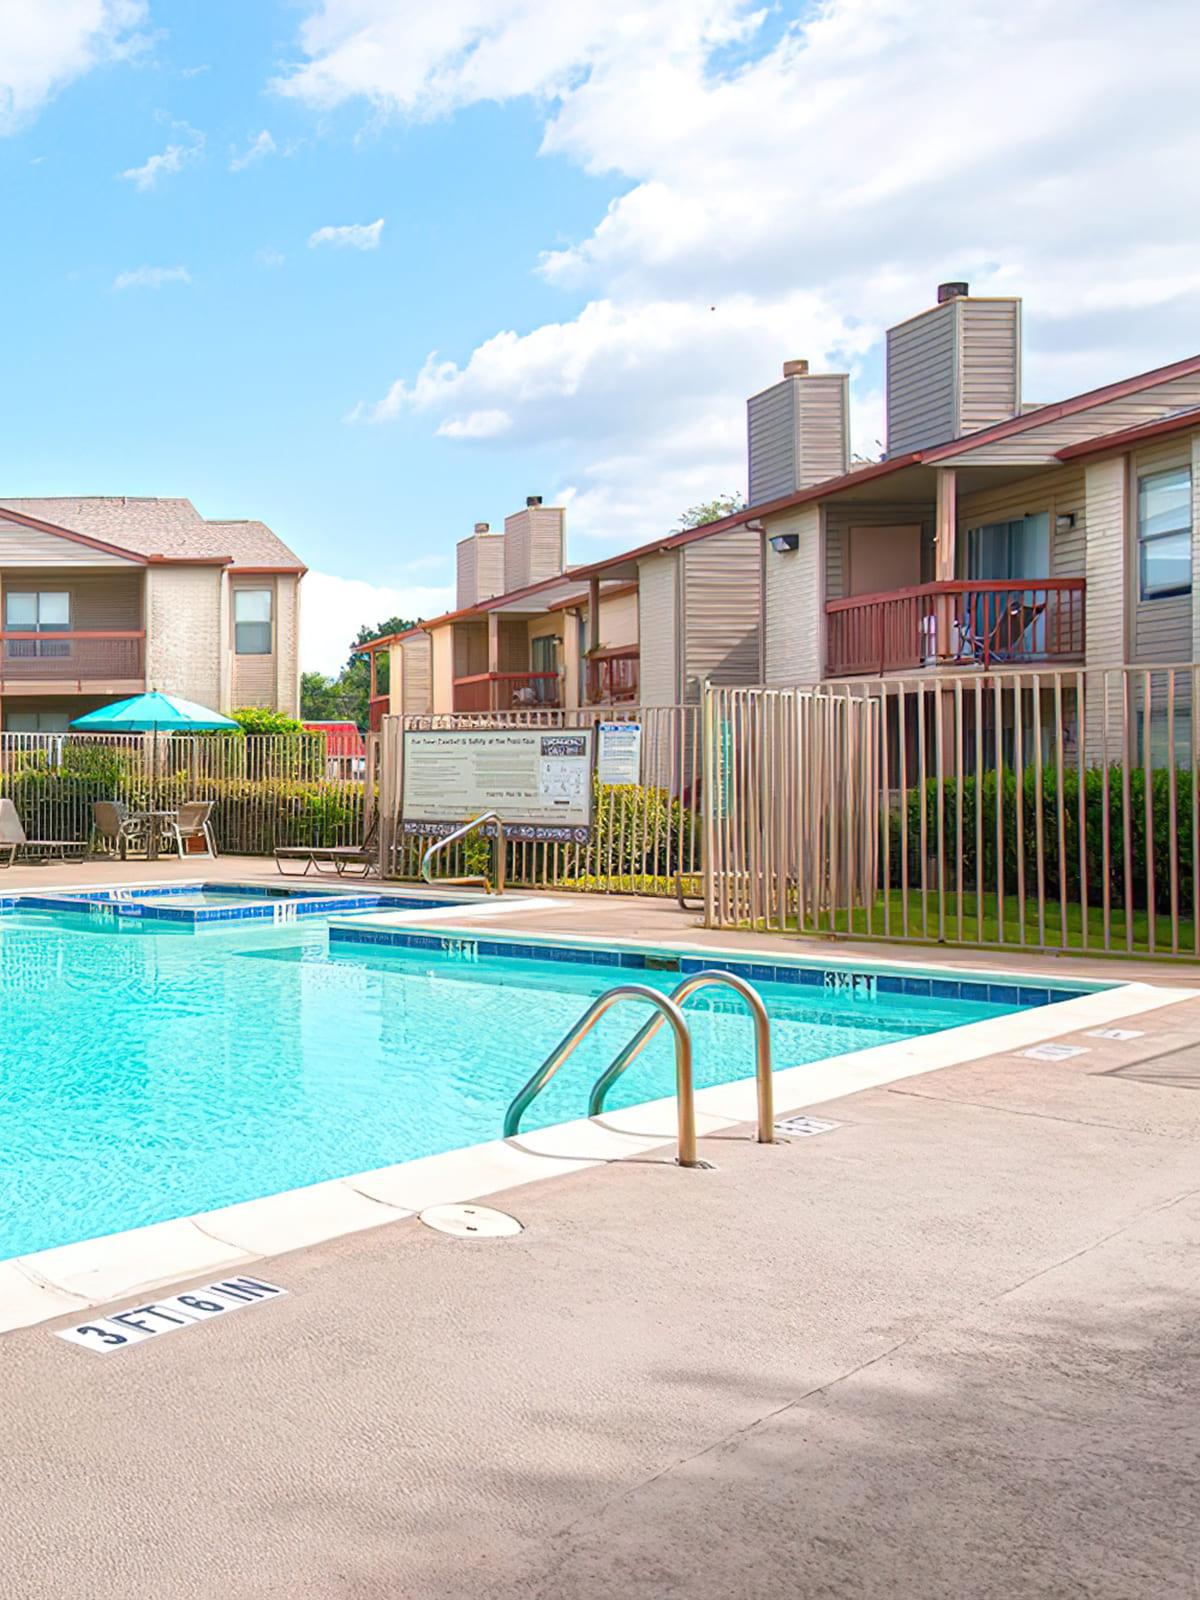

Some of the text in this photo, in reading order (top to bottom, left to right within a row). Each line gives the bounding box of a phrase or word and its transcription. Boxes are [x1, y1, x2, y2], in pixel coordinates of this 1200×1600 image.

[851, 973, 875, 991] FT
[76, 1278, 279, 1345] 3 FT 6 IN
